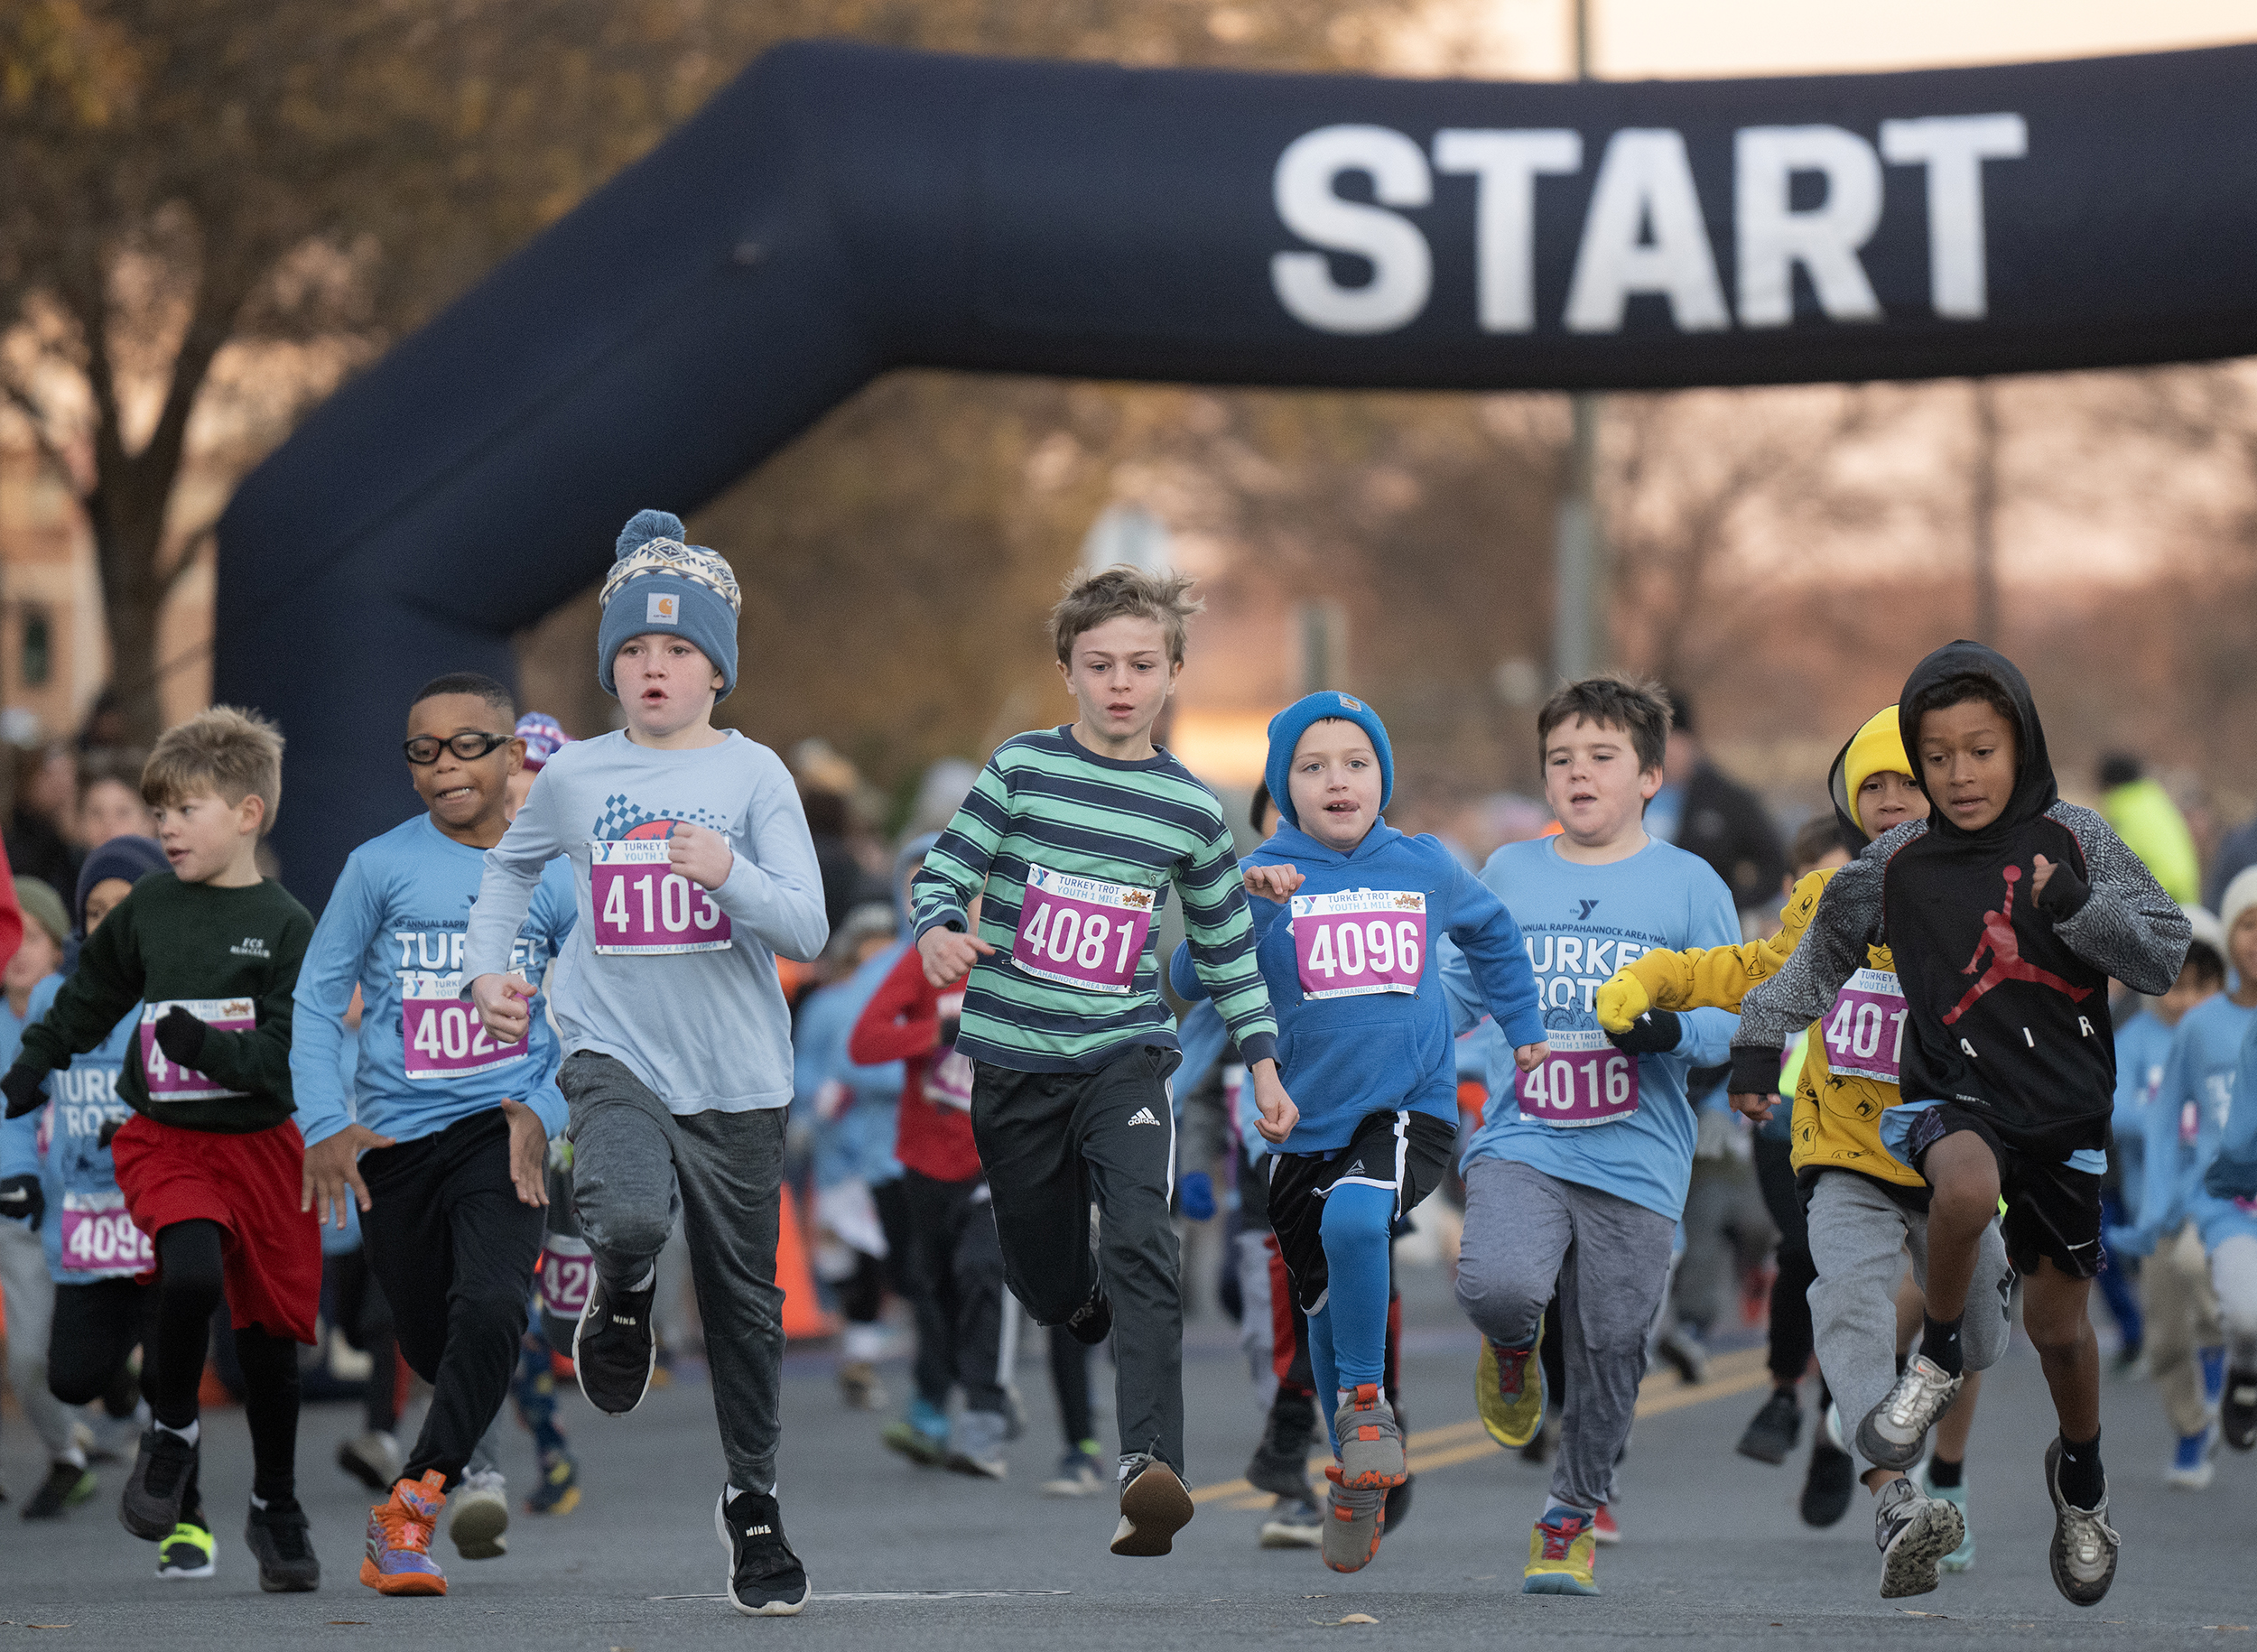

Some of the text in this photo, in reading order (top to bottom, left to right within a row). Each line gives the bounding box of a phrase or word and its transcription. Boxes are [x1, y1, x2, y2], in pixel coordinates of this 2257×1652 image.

[1269, 113, 2028, 334] START
[624, 842, 662, 851] TURKEY
[625, 852, 664, 861] YOUTH 1
[1059, 876, 1120, 895] TURKEY TROT
[1057, 885, 1119, 905] YOUTH 1 MILE
[1328, 892, 1389, 903] TURKEY TROT
[603, 873, 720, 933] 4103
[1329, 901, 1392, 912] YOUTH 1 MILE
[406, 919, 441, 928] ANNUAL
[1023, 902, 1135, 974] 4081
[1549, 923, 1623, 936] RAPPAHANNOCK
[1624, 929, 1647, 941] AREA
[612, 941, 718, 954] RAPPAHANNOCK AREA YMCA
[1308, 920, 1419, 979] 4096
[1524, 935, 1652, 976] URKE
[1021, 963, 1119, 992] RAPPAHANNOCK AREA YMCA
[1862, 970, 1893, 983] TURKEY
[434, 979, 460, 988] TURK
[1860, 980, 1888, 990] YOUTH
[1890, 985, 1895, 993] 1
[435, 988, 460, 997] YOUT
[1319, 985, 1380, 998] RAPPAHANNOCK
[1383, 984, 1399, 992] AREA
[413, 1007, 519, 1060] 402
[1547, 1032, 1602, 1041] URKEY TROT
[1826, 999, 1909, 1063] 401
[1547, 1041, 1573, 1049] OUTH
[1583, 1040, 1603, 1049] MILE
[1524, 1056, 1630, 1110] 4016
[1128, 1118, 1161, 1127] adidas
[613, 1313, 636, 1326] NIKE
[746, 1524, 772, 1537] NIKE
